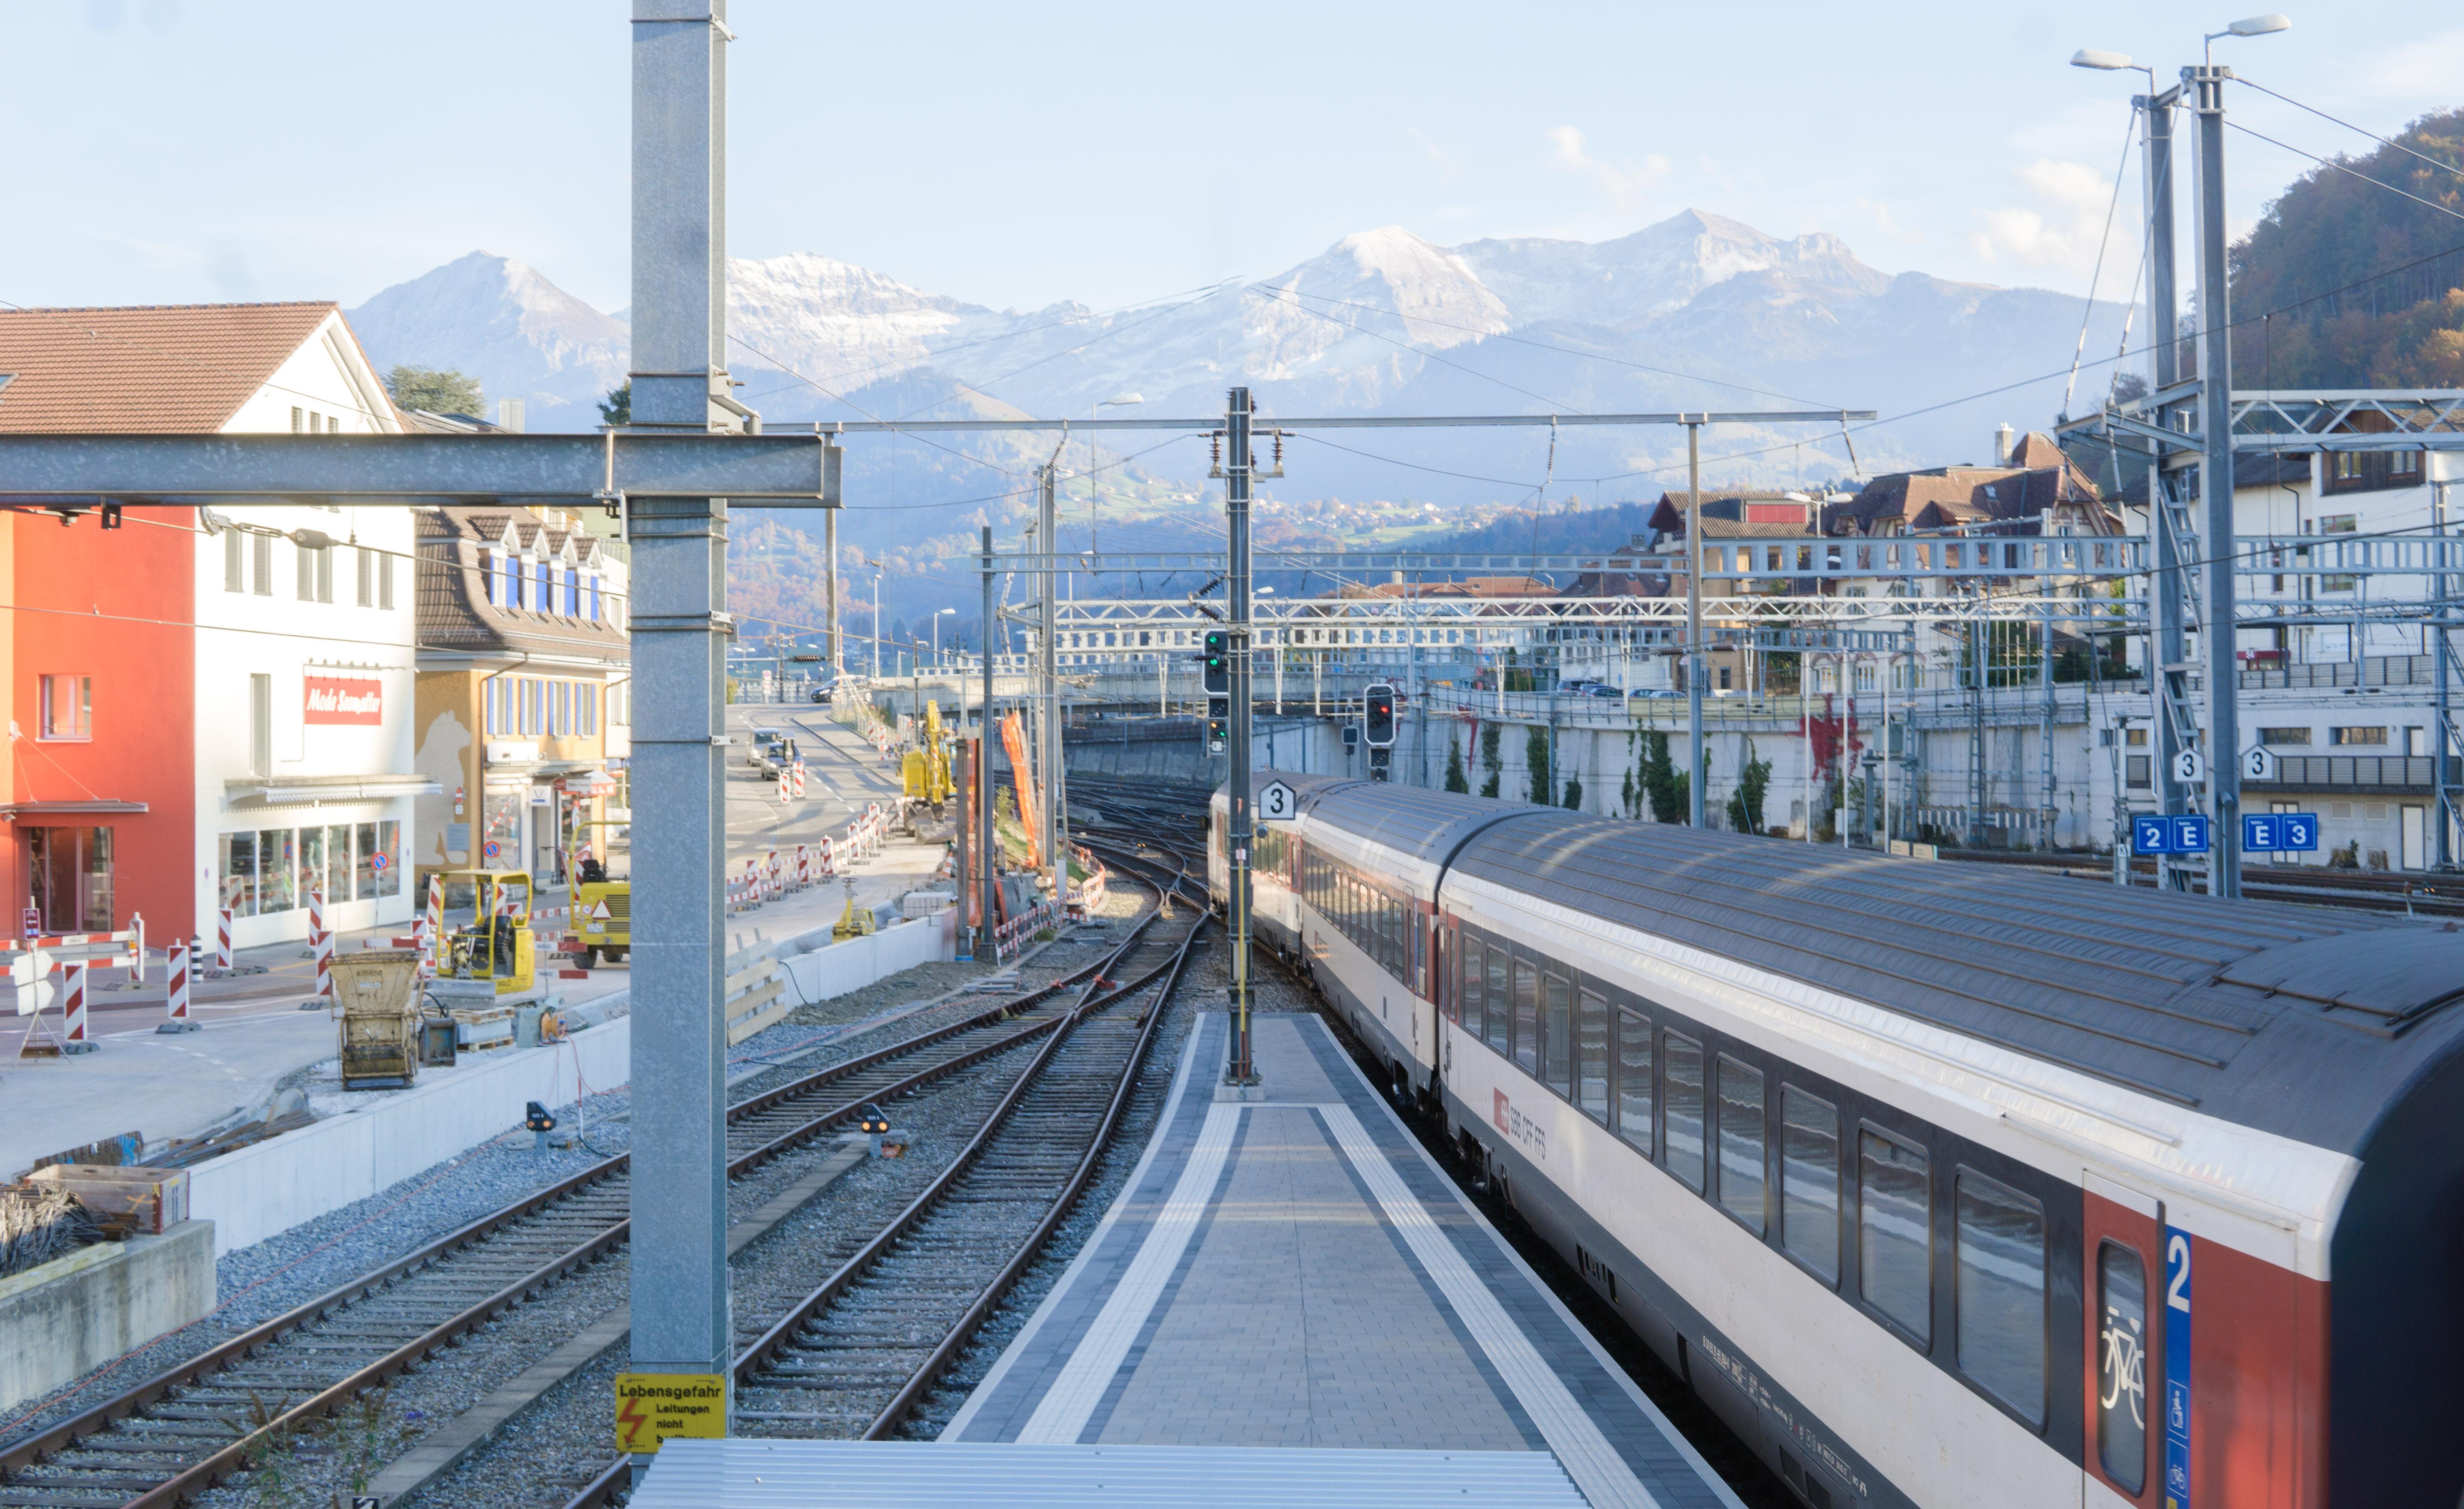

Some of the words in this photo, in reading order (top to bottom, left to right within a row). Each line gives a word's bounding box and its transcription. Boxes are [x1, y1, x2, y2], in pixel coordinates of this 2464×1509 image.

[307, 688, 337, 711] Mode
[2183, 754, 2194, 777] 3
[2252, 752, 2263, 774] 3
[1271, 788, 1283, 813] 3
[2146, 828, 2160, 847] 2
[2183, 826, 2197, 846] E
[2256, 825, 2269, 845] E
[2292, 825, 2307, 845] 3
[1510, 1105, 1521, 1139] SBB
[1523, 1116, 1533, 1149] CFF
[1535, 1125, 1545, 1160] FFS
[2167, 1235, 2190, 1313] 2
[620, 1385, 721, 1399] Lebensgefahr
[657, 1404, 710, 1415] Leitungen
[657, 1419, 684, 1428] nicht
